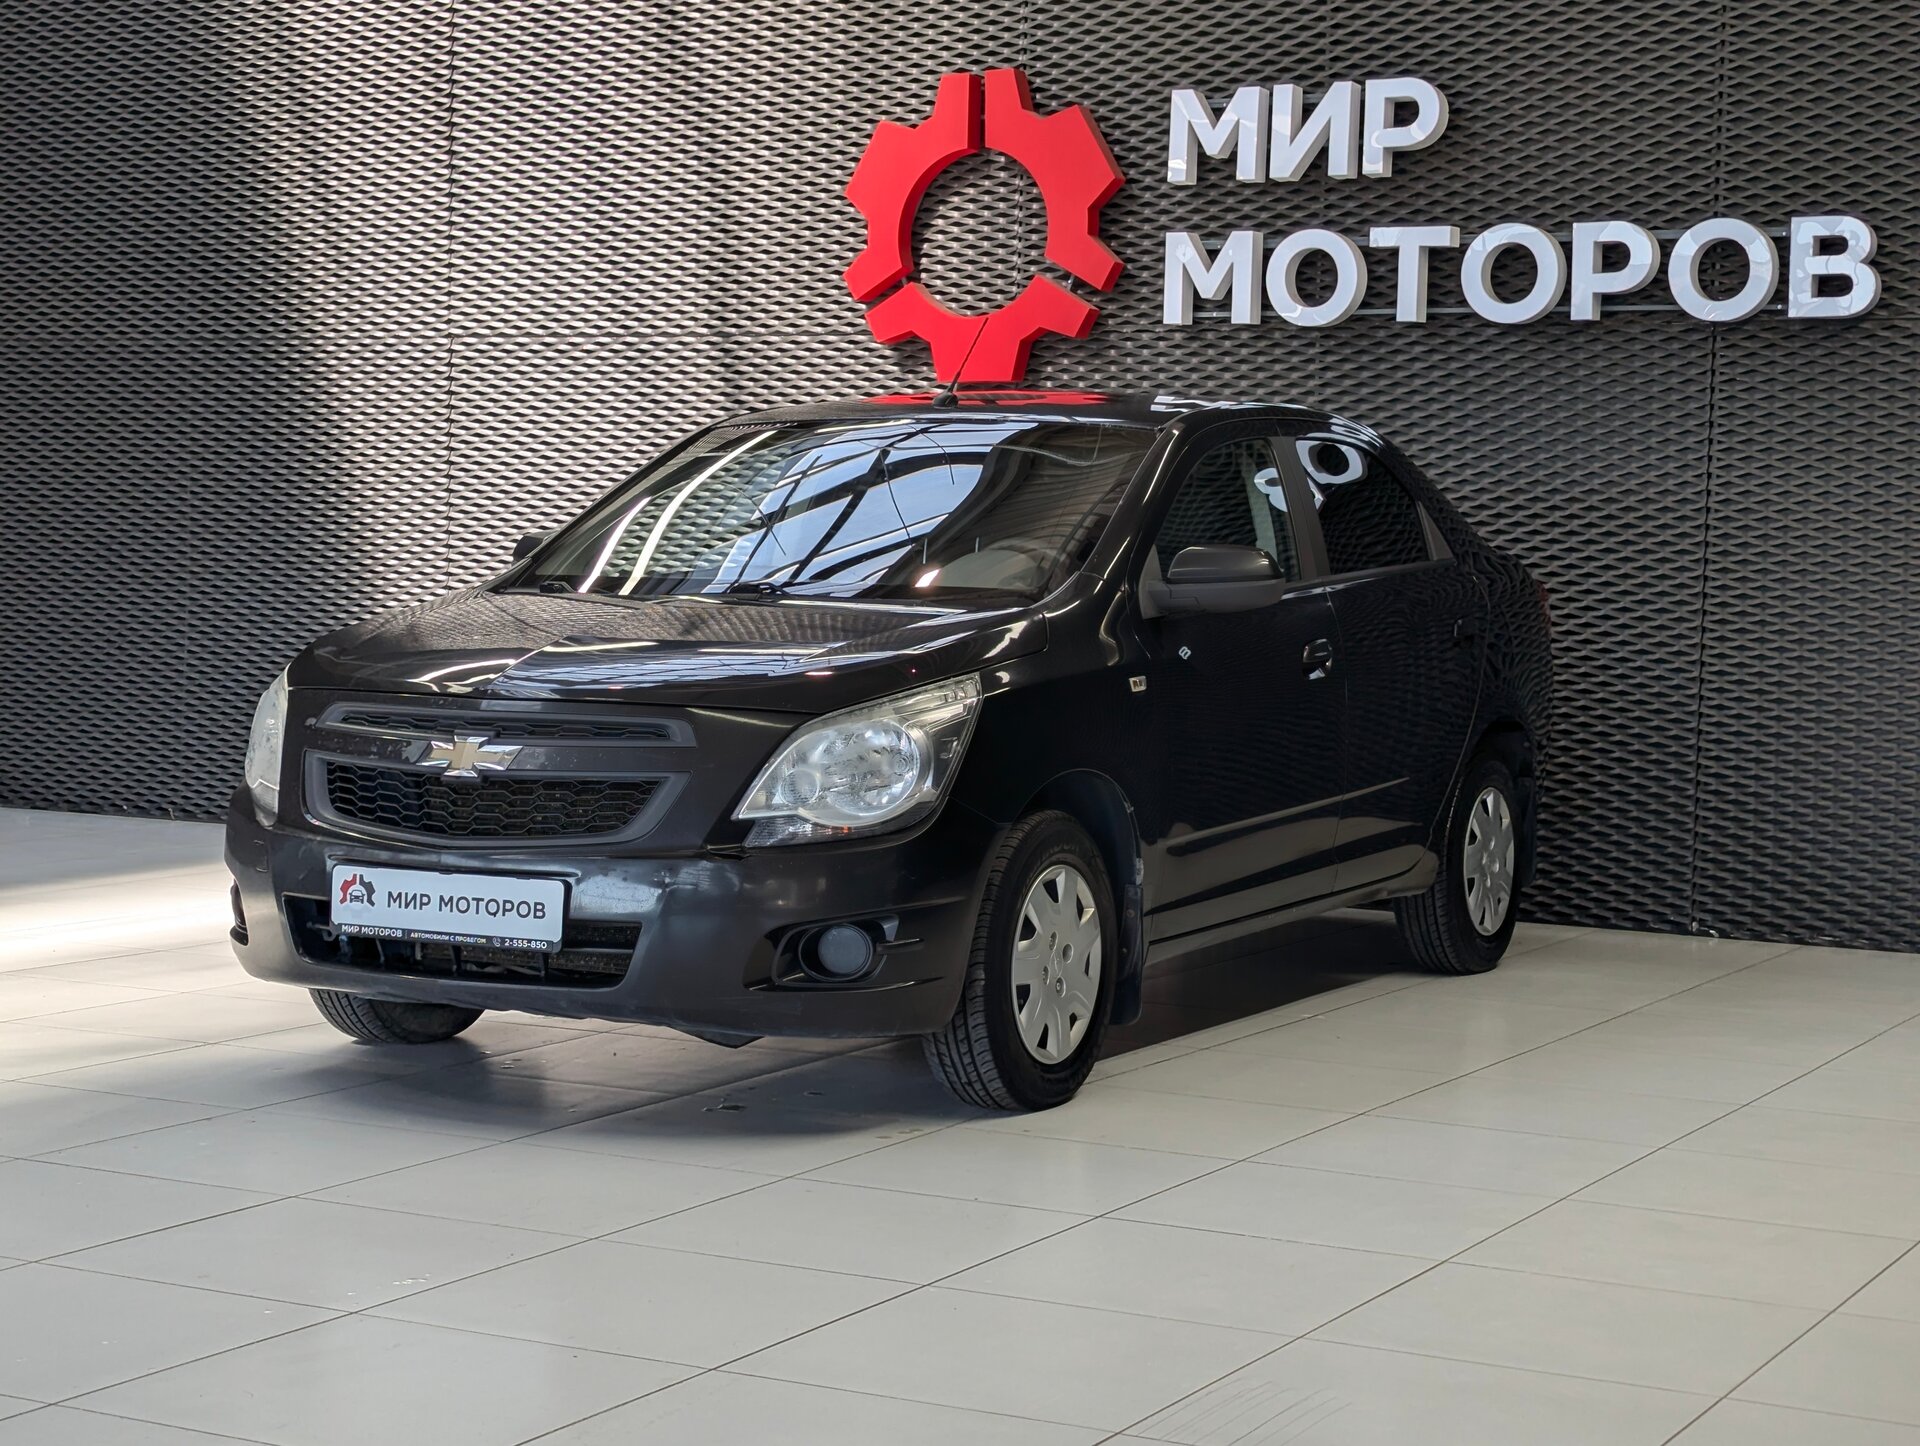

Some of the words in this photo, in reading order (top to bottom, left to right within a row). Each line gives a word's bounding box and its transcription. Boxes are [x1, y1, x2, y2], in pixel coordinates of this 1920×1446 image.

[1167, 76, 1449, 185] МИР
[1162, 215, 1881, 327] МОТОРОВ
[341, 924, 360, 934] МИР
[361, 926, 403, 938] МОТОРОВ
[504, 938, 548, 949] 2-555-850
[386, 891, 431, 911] МИР
[438, 895, 546, 919] МОТОРОВ
